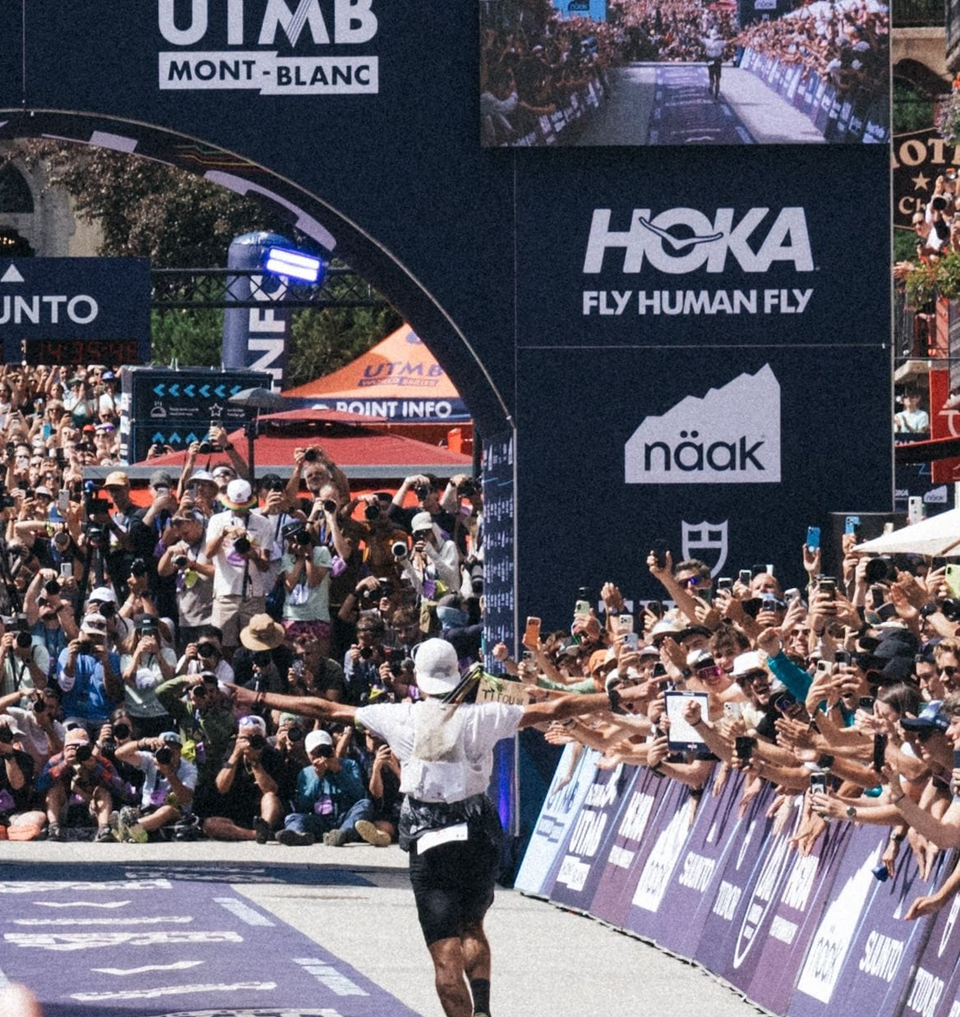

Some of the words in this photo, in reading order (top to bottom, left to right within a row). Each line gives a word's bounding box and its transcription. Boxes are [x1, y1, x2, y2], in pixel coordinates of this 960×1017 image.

[158, 0, 379, 47] UTMB
[582, 206, 815, 275] HOKA
[582, 290, 633, 316] FLY
[638, 289, 758, 316] HUMAN
[763, 288, 814, 315] FLY
[363, 360, 444, 379] UTMB
[336, 400, 399, 419] POINT
[401, 400, 452, 419] INFO
[644, 430, 765, 472] näak
[858, 929, 905, 983] SUUNTO
